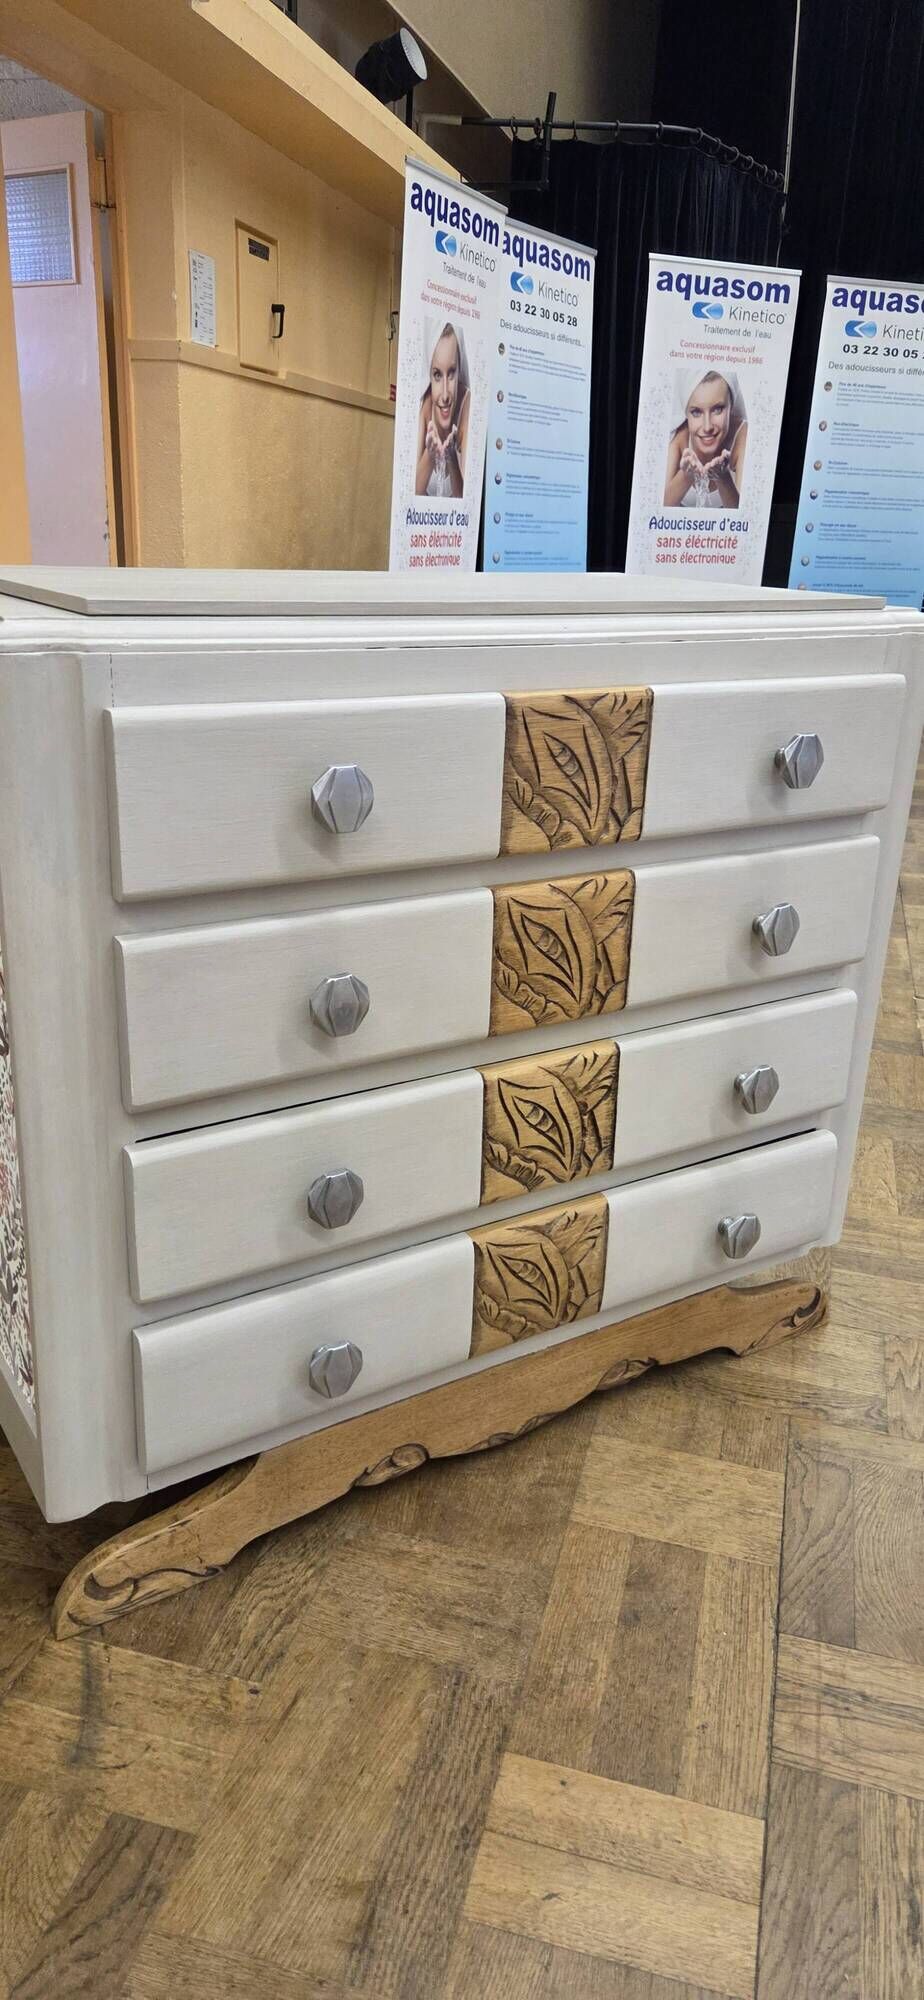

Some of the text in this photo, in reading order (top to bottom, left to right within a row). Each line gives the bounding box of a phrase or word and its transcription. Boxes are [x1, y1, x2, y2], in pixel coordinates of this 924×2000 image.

[411, 182, 499, 247] aquasom
[460, 242, 496, 272] Kinetico
[502, 230, 591, 281] aquasom
[538, 280, 578, 307] Kinetico
[656, 270, 791, 304] aquasom
[832, 287, 924, 316] aquas
[510, 299, 578, 327] 03 22 30 05 28
[728, 306, 785, 325] Kinetico
[500, 318, 512, 330] Des
[704, 324, 772, 339] Traitement de l'eau
[680, 339, 756, 354] Concessionnaire exclusif
[843, 344, 858, 354] 03
[863, 345, 879, 356] 22
[883, 347, 899, 357] 30
[903, 349, 918, 359] 05
[669, 350, 685, 358] dans
[686, 351, 702, 360] votre
[828, 361, 843, 370] Des
[845, 362, 896, 374] adoucisseurs
[648, 516, 749, 532] Adoucisseur d'eau
[410, 533, 427, 548] sans
[656, 536, 682, 548] sans
[408, 555, 424, 568] sans
[655, 551, 736, 564] sans électronique
